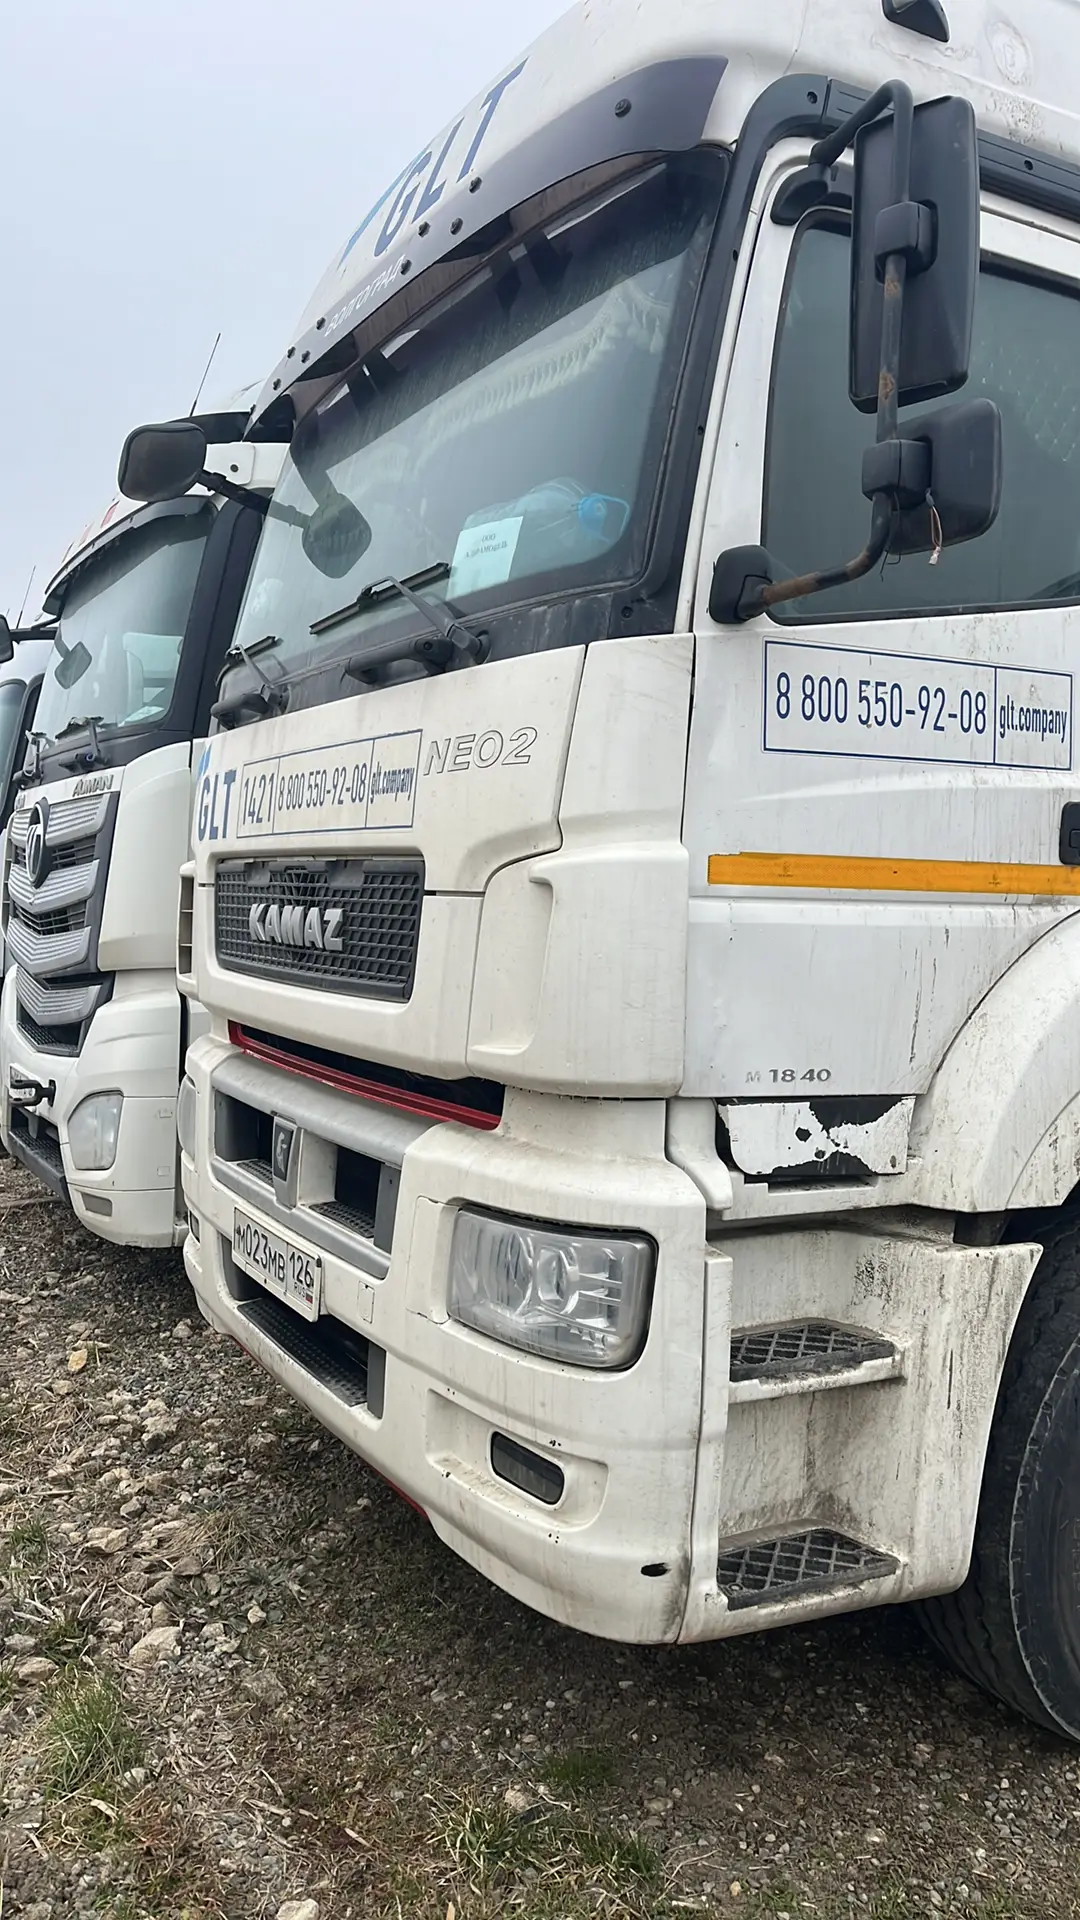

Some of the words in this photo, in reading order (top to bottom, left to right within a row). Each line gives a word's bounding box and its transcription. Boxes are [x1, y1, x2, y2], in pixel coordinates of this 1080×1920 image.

[374, 56, 530, 257] GLT
[776, 672, 791, 719] 8
[801, 674, 848, 723] 800
[858, 680, 987, 734] 550-92-08
[999, 695, 1067, 743] glt.company
[423, 726, 538, 777] NEO2
[72, 774, 114, 797] AUMAN
[198, 768, 237, 841] GLT
[242, 772, 275, 826] 1421
[277, 775, 286, 811] 8
[286, 772, 305, 810] 800
[306, 763, 368, 808] 550-92-08
[370, 761, 415, 804] glt.company
[250, 903, 345, 951] KAMAZ
